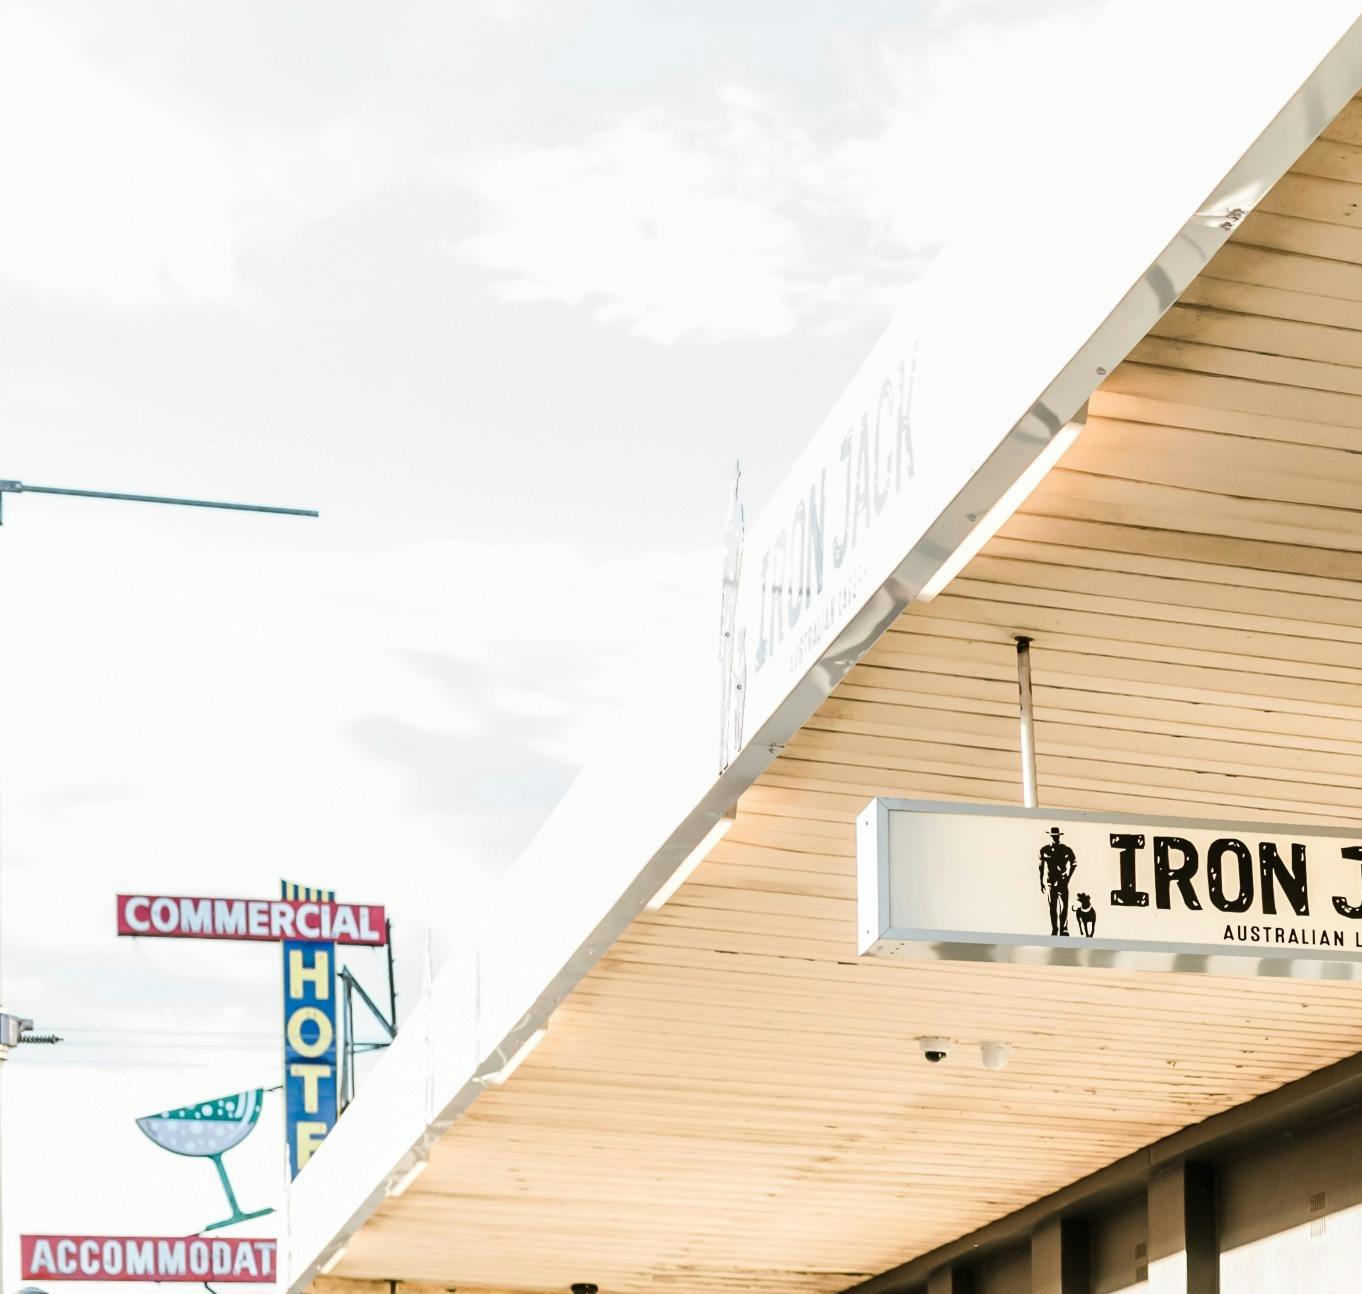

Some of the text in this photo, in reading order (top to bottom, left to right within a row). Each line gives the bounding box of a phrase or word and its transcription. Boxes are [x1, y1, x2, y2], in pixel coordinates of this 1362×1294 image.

[755, 338, 920, 674] IRON JACK
[1109, 832, 1309, 917] IRON
[124, 896, 381, 941] COMMERCIAL
[1223, 924, 1345, 947] AUSTRALIAN
[30, 1238, 277, 1276] ACCOMMODAT
